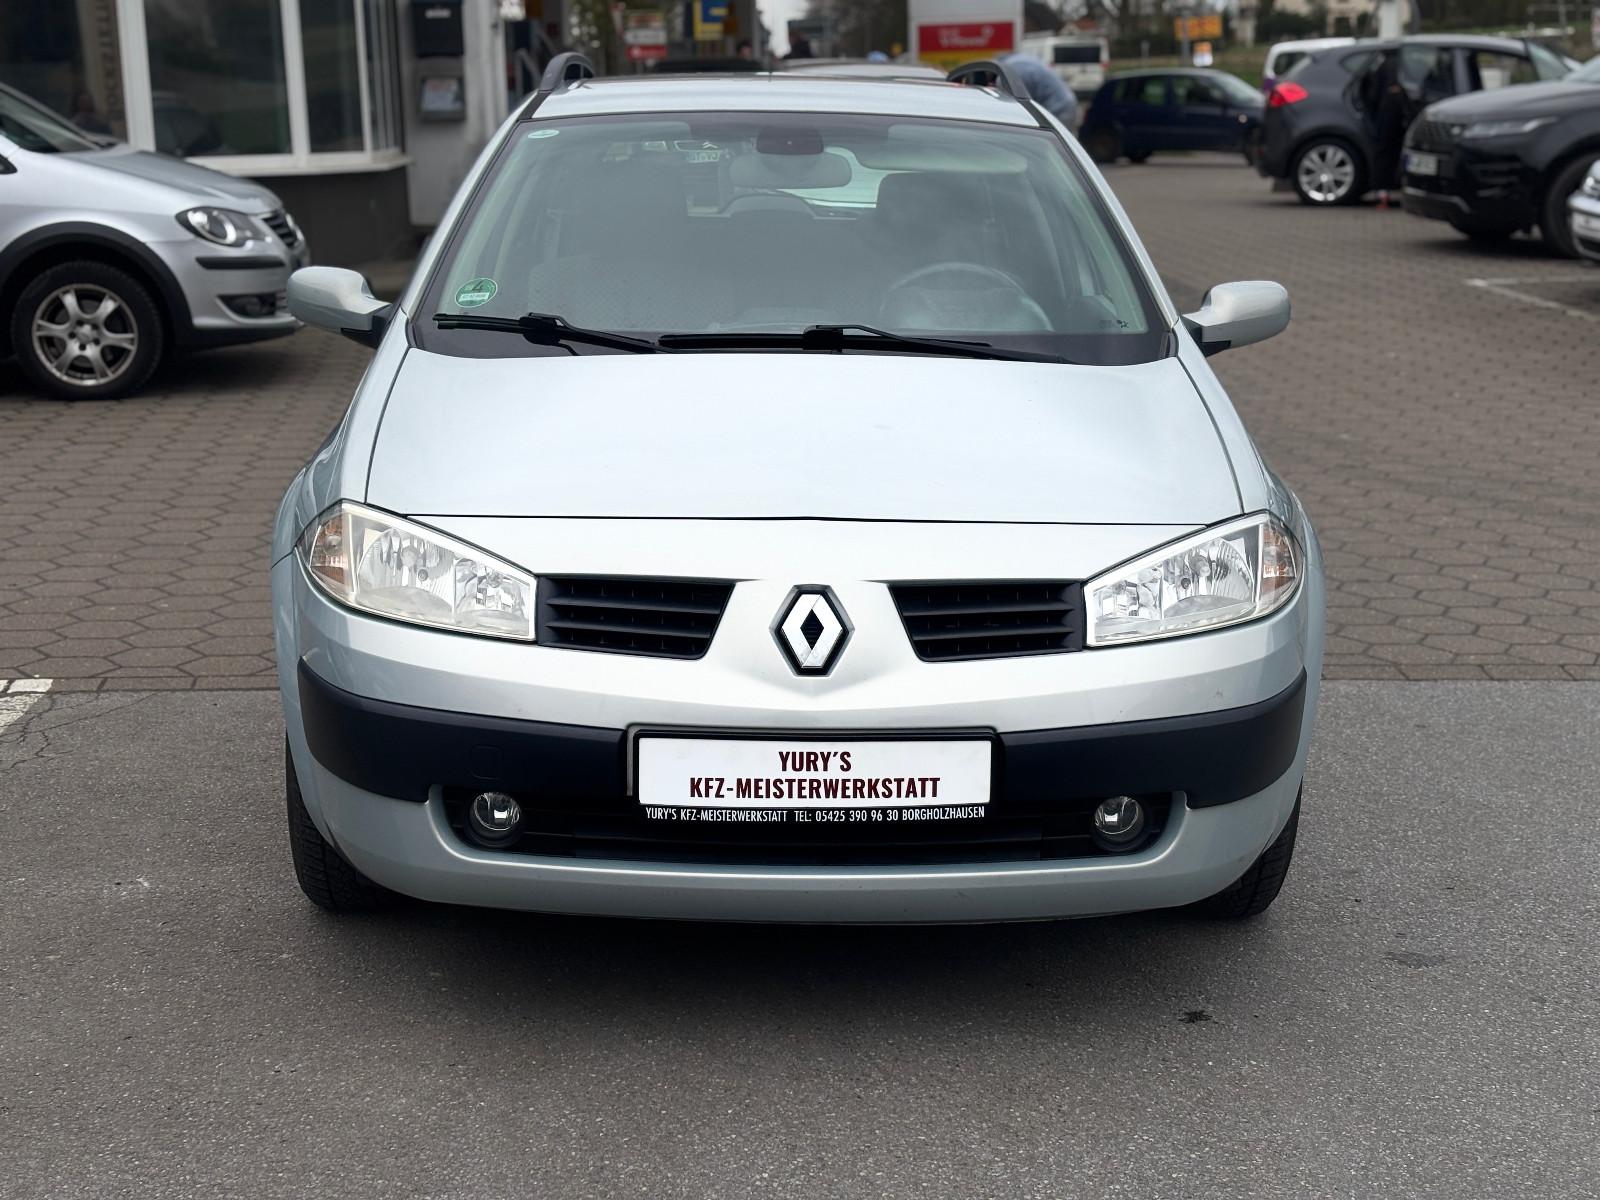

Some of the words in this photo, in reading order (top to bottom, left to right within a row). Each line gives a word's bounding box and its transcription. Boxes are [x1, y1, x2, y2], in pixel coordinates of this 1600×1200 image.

[690, 777, 941, 799] KFZ-MEISTERWERKSTATT
[645, 807, 677, 820] YURY'S
[680, 808, 788, 822] KFZ-MEISTERWERKSTATT
[794, 810, 812, 822] TEL:
[815, 810, 846, 822] 05425
[849, 810, 868, 822] 390
[870, 810, 883, 821] 96
[886, 809, 899, 821] 30
[902, 806, 985, 821] BORGHOLZHAUSEN
